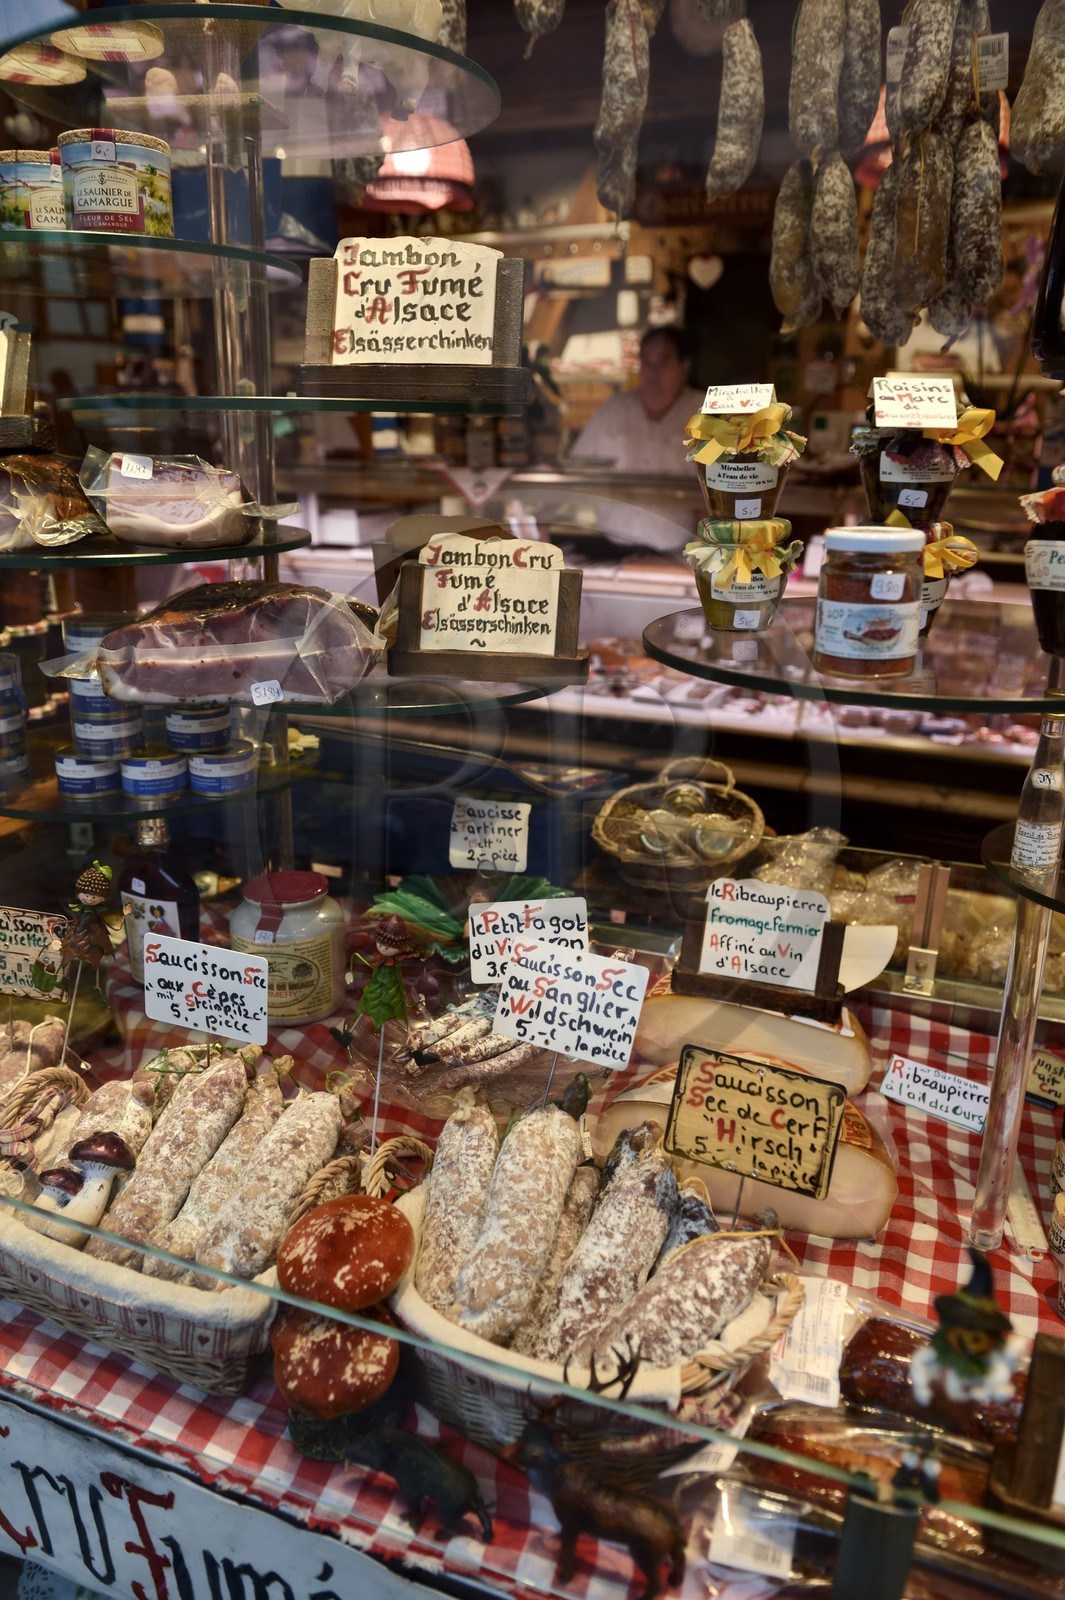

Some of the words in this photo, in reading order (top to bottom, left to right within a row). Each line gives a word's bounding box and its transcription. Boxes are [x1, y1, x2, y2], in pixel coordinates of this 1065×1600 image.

[77, 198, 133, 208] CAMARGUE
[83, 187, 123, 197] SAUNIER
[124, 190, 132, 198] DE
[36, 214, 66, 225] CAMA
[43, 205, 66, 215] SAUN
[343, 243, 462, 267] Jambon
[343, 270, 392, 297] Cru
[396, 262, 484, 299] Fumé
[354, 296, 472, 325] d'Alsace
[709, 386, 770, 397] Mirabelles
[875, 379, 952, 394] Raisins
[739, 399, 762, 408] Vie
[896, 393, 949, 404] Marc
[720, 464, 756, 472] Mirabelles
[722, 472, 738, 480] l'eau
[749, 472, 759, 480] vie
[427, 543, 514, 570] Jambon
[512, 545, 554, 571] Cru
[435, 567, 496, 590] Fumé
[421, 608, 552, 635] Elsässerschinken
[455, 803, 522, 821] Saucisse
[457, 819, 523, 838] Tartiner
[491, 848, 520, 864] pièce
[711, 883, 723, 898] le
[721, 882, 827, 914] Ribeaupierre
[481, 911, 524, 934] Petit
[522, 906, 587, 935] Fagot
[0, 931, 47, 948] oisettes
[709, 933, 756, 955] Affiné
[759, 946, 777, 959] au
[777, 942, 803, 962] Vin
[472, 943, 496, 960] du
[145, 944, 242, 984] Saucisson
[510, 942, 597, 987] Saucisson
[595, 967, 639, 1002] Sec
[715, 954, 791, 979] d'Alsace
[157, 978, 184, 992] aux
[192, 981, 245, 1007] Cèpes
[508, 975, 530, 993] au
[532, 976, 629, 1019] Sanglier
[892, 1059, 989, 1105] Ribeaupierre
[1032, 1065, 1061, 1087] Lait
[693, 1060, 819, 1116] Saucisson
[1039, 1082, 1062, 1099] Cru
[686, 1085, 729, 1114] Sec
[737, 1103, 772, 1128] de
[951, 1105, 986, 1126] Ours
